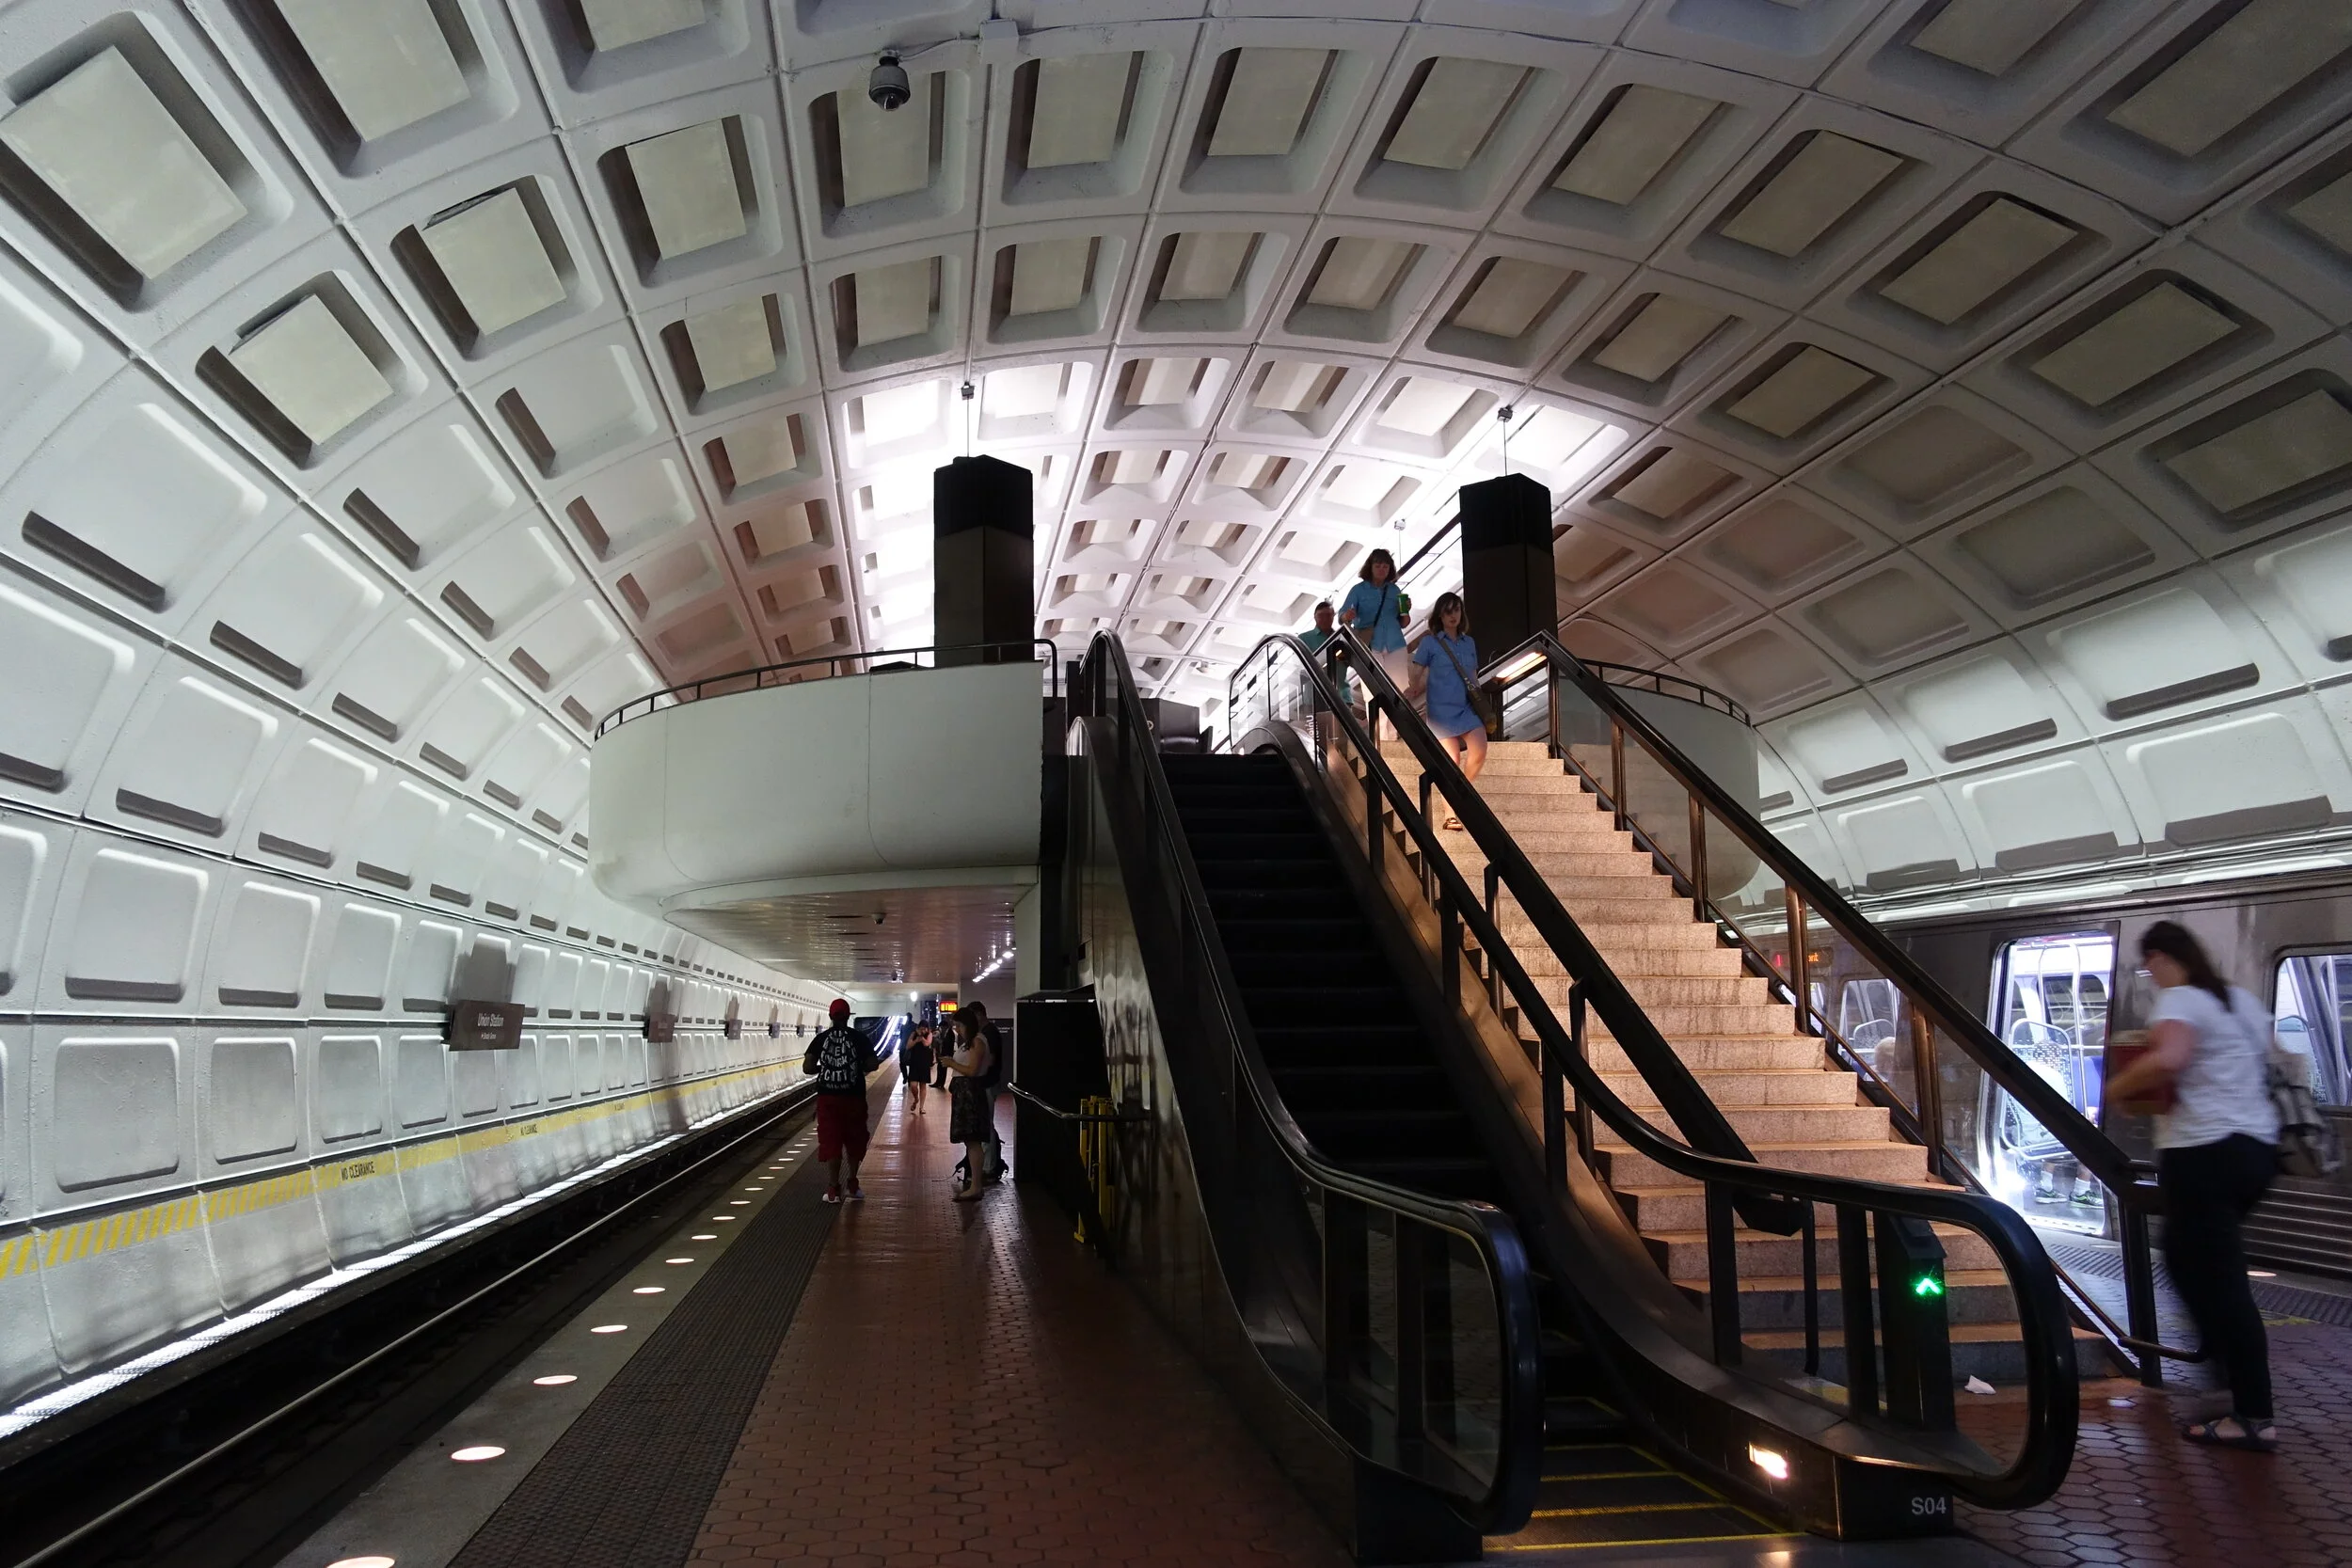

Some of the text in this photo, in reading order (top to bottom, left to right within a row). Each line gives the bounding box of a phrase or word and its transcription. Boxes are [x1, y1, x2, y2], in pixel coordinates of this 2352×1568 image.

[341, 1161, 375, 1180] NO CLEARANCE
[1911, 1497, 1947, 1515] S04
